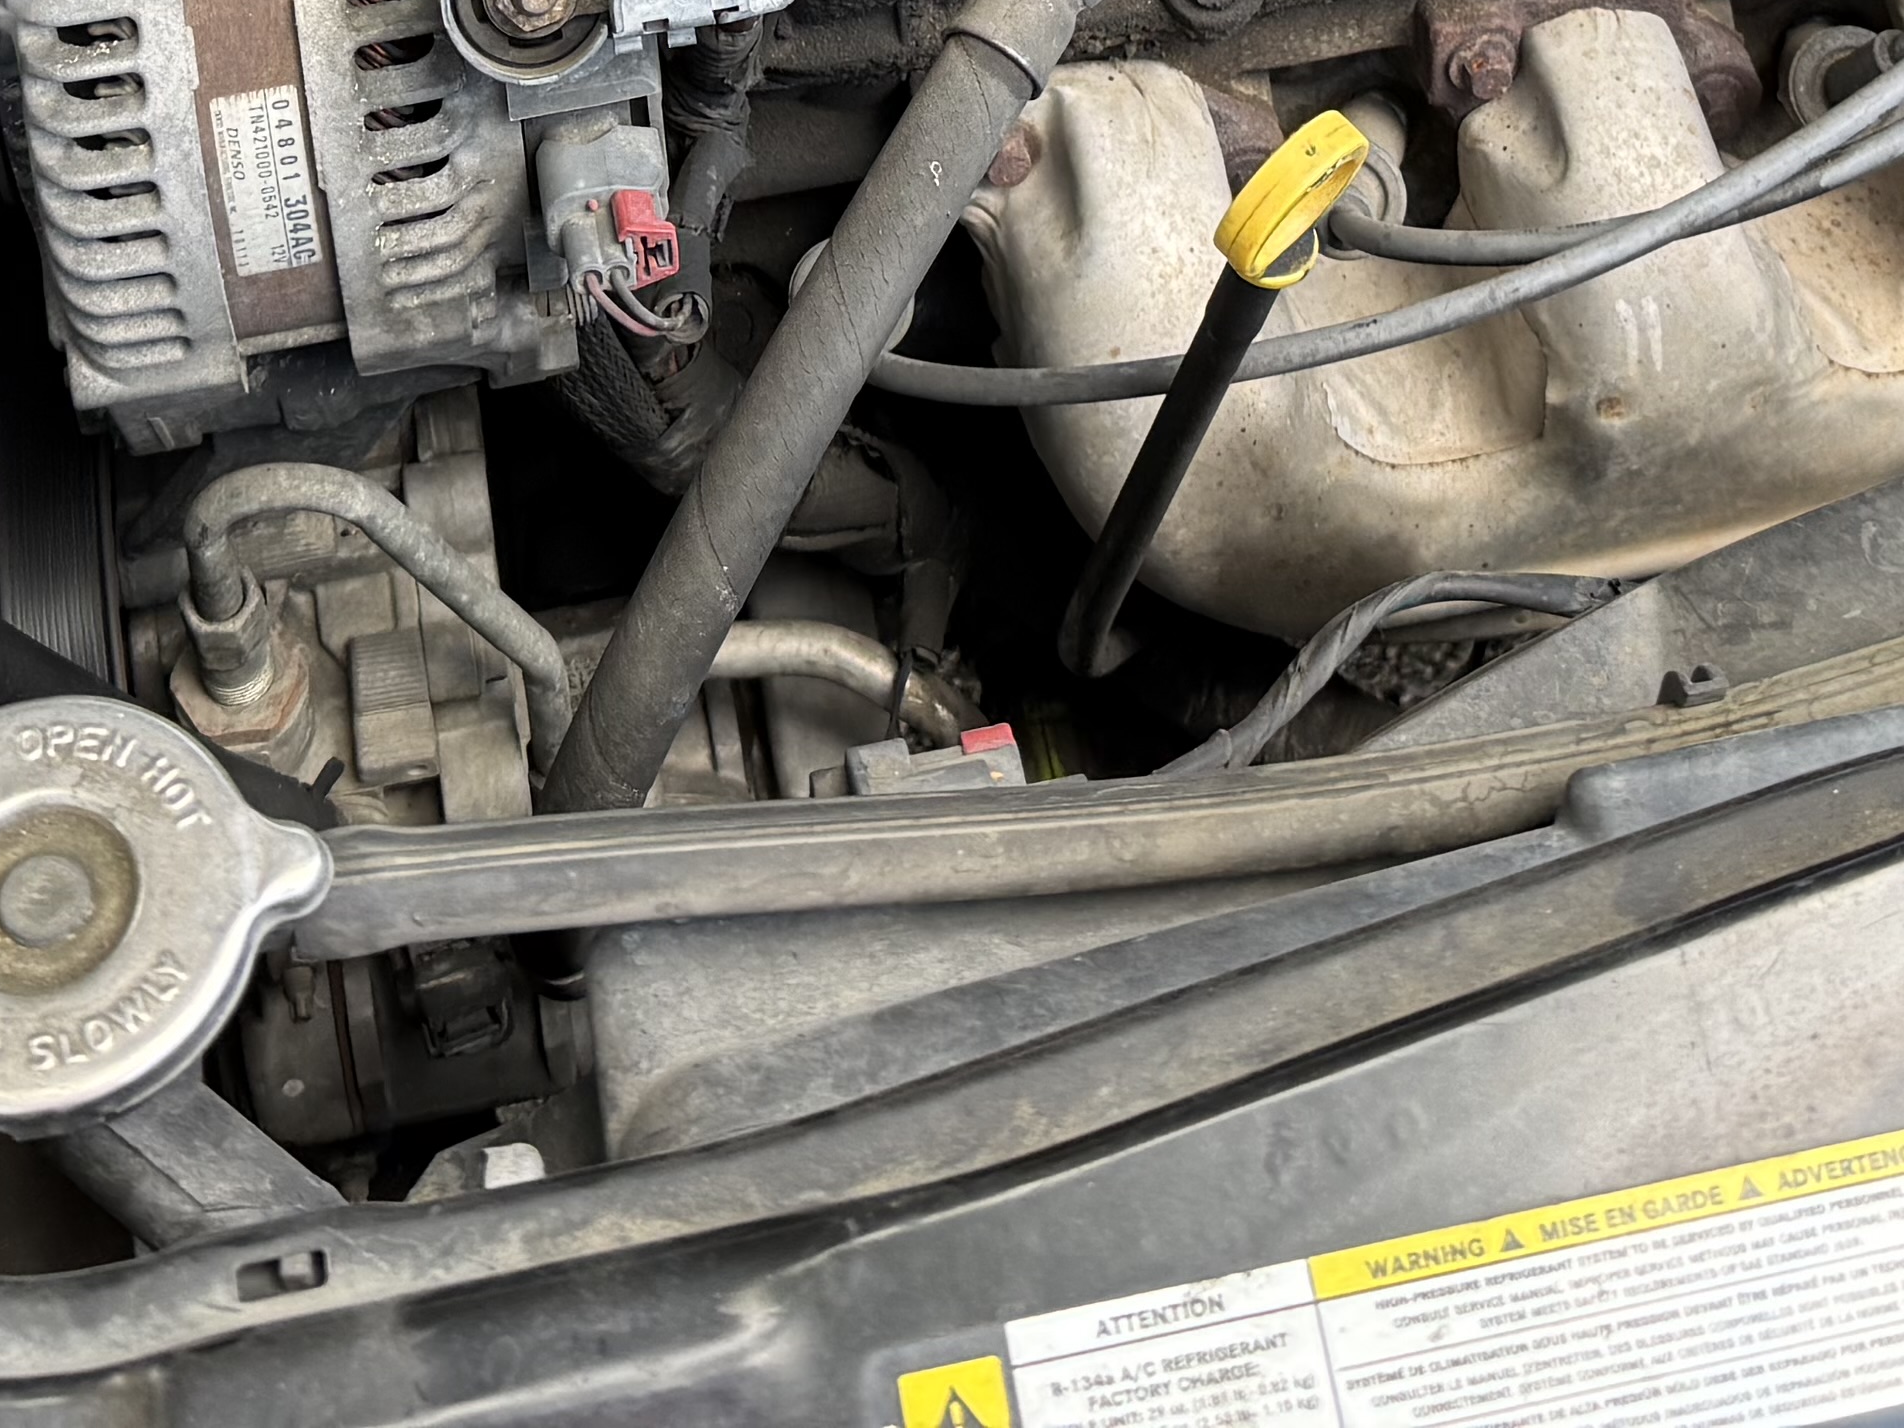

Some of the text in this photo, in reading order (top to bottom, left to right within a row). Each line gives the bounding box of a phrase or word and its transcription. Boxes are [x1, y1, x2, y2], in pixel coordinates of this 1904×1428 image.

[225, 126, 247, 181] DENSO
[270, 243, 286, 264] 12V
[14, 724, 139, 768] OPEN
[141, 753, 214, 831] HOT
[28, 949, 190, 1073] SLOWLY
[1365, 1235, 1486, 1282] WARNING
[1538, 1211, 1599, 1243] MISE
[1603, 1203, 1637, 1228] EN
[1639, 1183, 1724, 1221] GARDE
[1093, 1292, 1226, 1341] ATTENTION
[1118, 1361, 1157, 1383] A/C
[1161, 1331, 1289, 1374] REFRIGERANT
[1087, 1380, 1171, 1413] FACTORY
